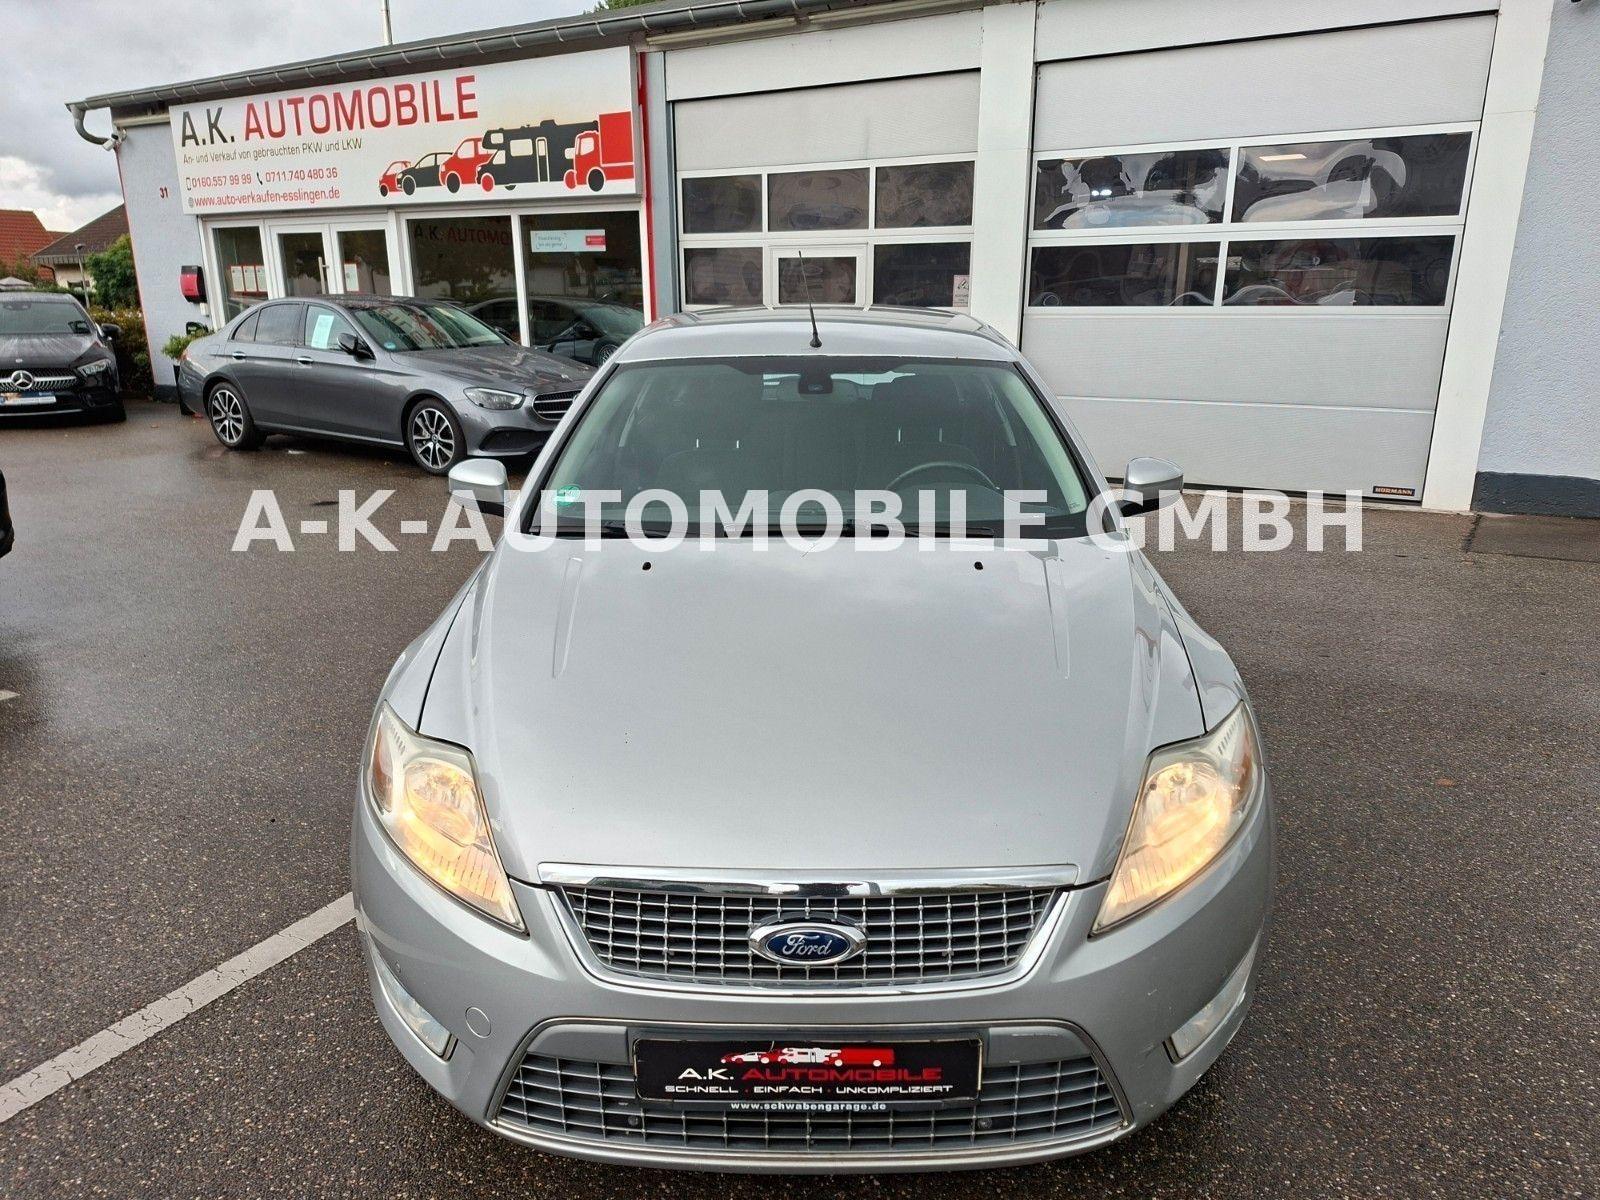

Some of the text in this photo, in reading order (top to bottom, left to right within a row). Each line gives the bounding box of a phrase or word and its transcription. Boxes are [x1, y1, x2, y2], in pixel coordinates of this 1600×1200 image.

[181, 75, 478, 147] A.K. AUTOMOBILE
[196, 153, 208, 163] und
[210, 148, 237, 162] Verkauf
[238, 150, 251, 160] von
[253, 145, 300, 160] gebrauchten
[302, 141, 323, 154] PKW
[325, 140, 340, 152] und
[342, 138, 362, 150] LKW
[307, 168, 324, 180] 480
[326, 167, 338, 179] 36
[160, 187, 168, 198] 31
[194, 186, 340, 207] www.auto-verkaufen-esslingen.de
[782, 934, 832, 955] Ford
[678, 1068, 942, 1081] A.K. AUTOMOBILE
[754, 1086, 822, 1094] EINFACH
[836, 1085, 953, 1094] UNKOMPLIZIERT
